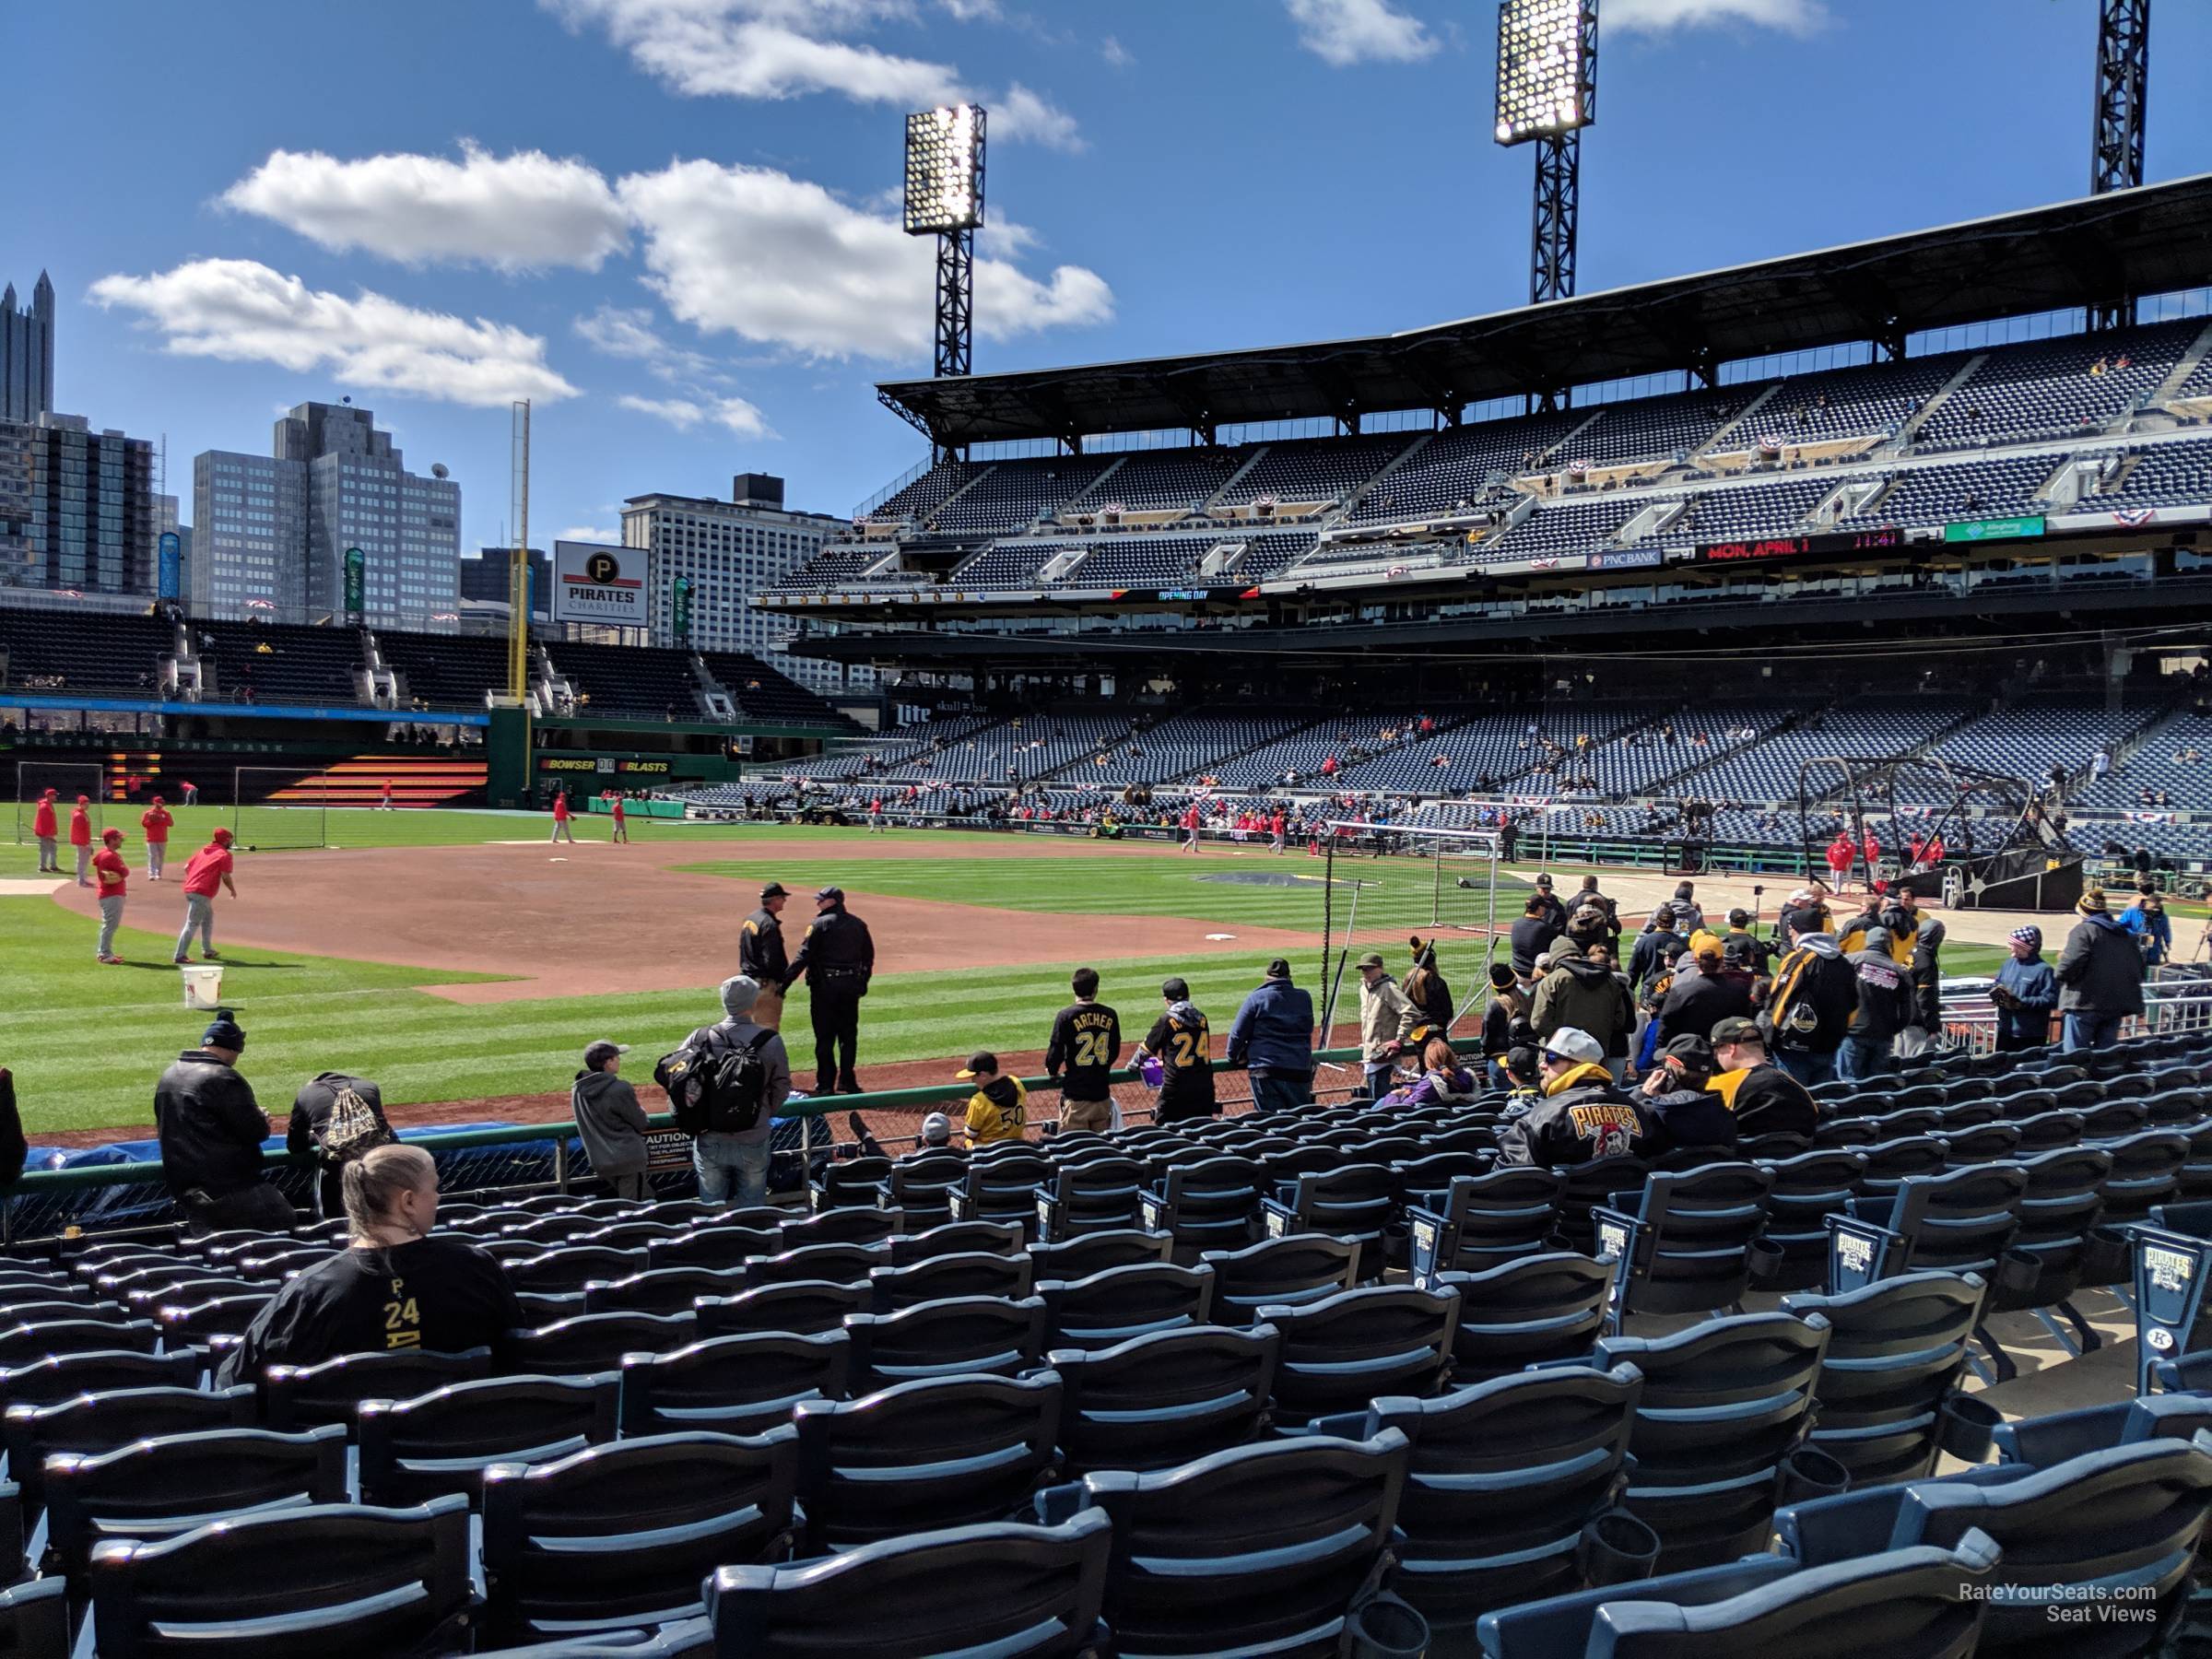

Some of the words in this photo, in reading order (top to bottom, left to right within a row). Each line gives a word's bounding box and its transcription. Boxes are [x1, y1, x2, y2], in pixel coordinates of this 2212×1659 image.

[1708, 543, 1750, 559] MON,
[1754, 540, 1796, 556] APRIL
[1797, 537, 1809, 552] 1
[1603, 554, 1626, 565] PNC
[1627, 552, 1657, 562] BANK
[596, 559, 611, 579] P
[569, 587, 635, 604] PIRATES
[1159, 590, 1193, 600] OPENING
[1193, 590, 1208, 600] DAY
[569, 600, 635, 613] CHARITIES
[936, 700, 960, 712] skull
[972, 702, 988, 712] bar
[896, 703, 931, 728] Lite
[15, 737, 119, 747] WELCOME
[138, 740, 159, 749] TO
[178, 741, 216, 751] PNC
[232, 743, 284, 753] PARK
[549, 759, 595, 771] BOWSER
[627, 761, 668, 772] BLASTS
[1073, 1013, 1113, 1031] ARCHER
[1076, 1030, 1110, 1066] 24
[1173, 1030, 1210, 1067] 24
[1000, 1105, 1024, 1132] 50
[1571, 1104, 1641, 1138] PIRATES
[645, 1133, 690, 1144] AUTION
[1838, 1232, 1872, 1262] PIRATES
[2145, 1246, 2193, 1279] PIRATES
[391, 1277, 404, 1294] P
[383, 1298, 420, 1329] 24
[2153, 1332, 2168, 1346] K
